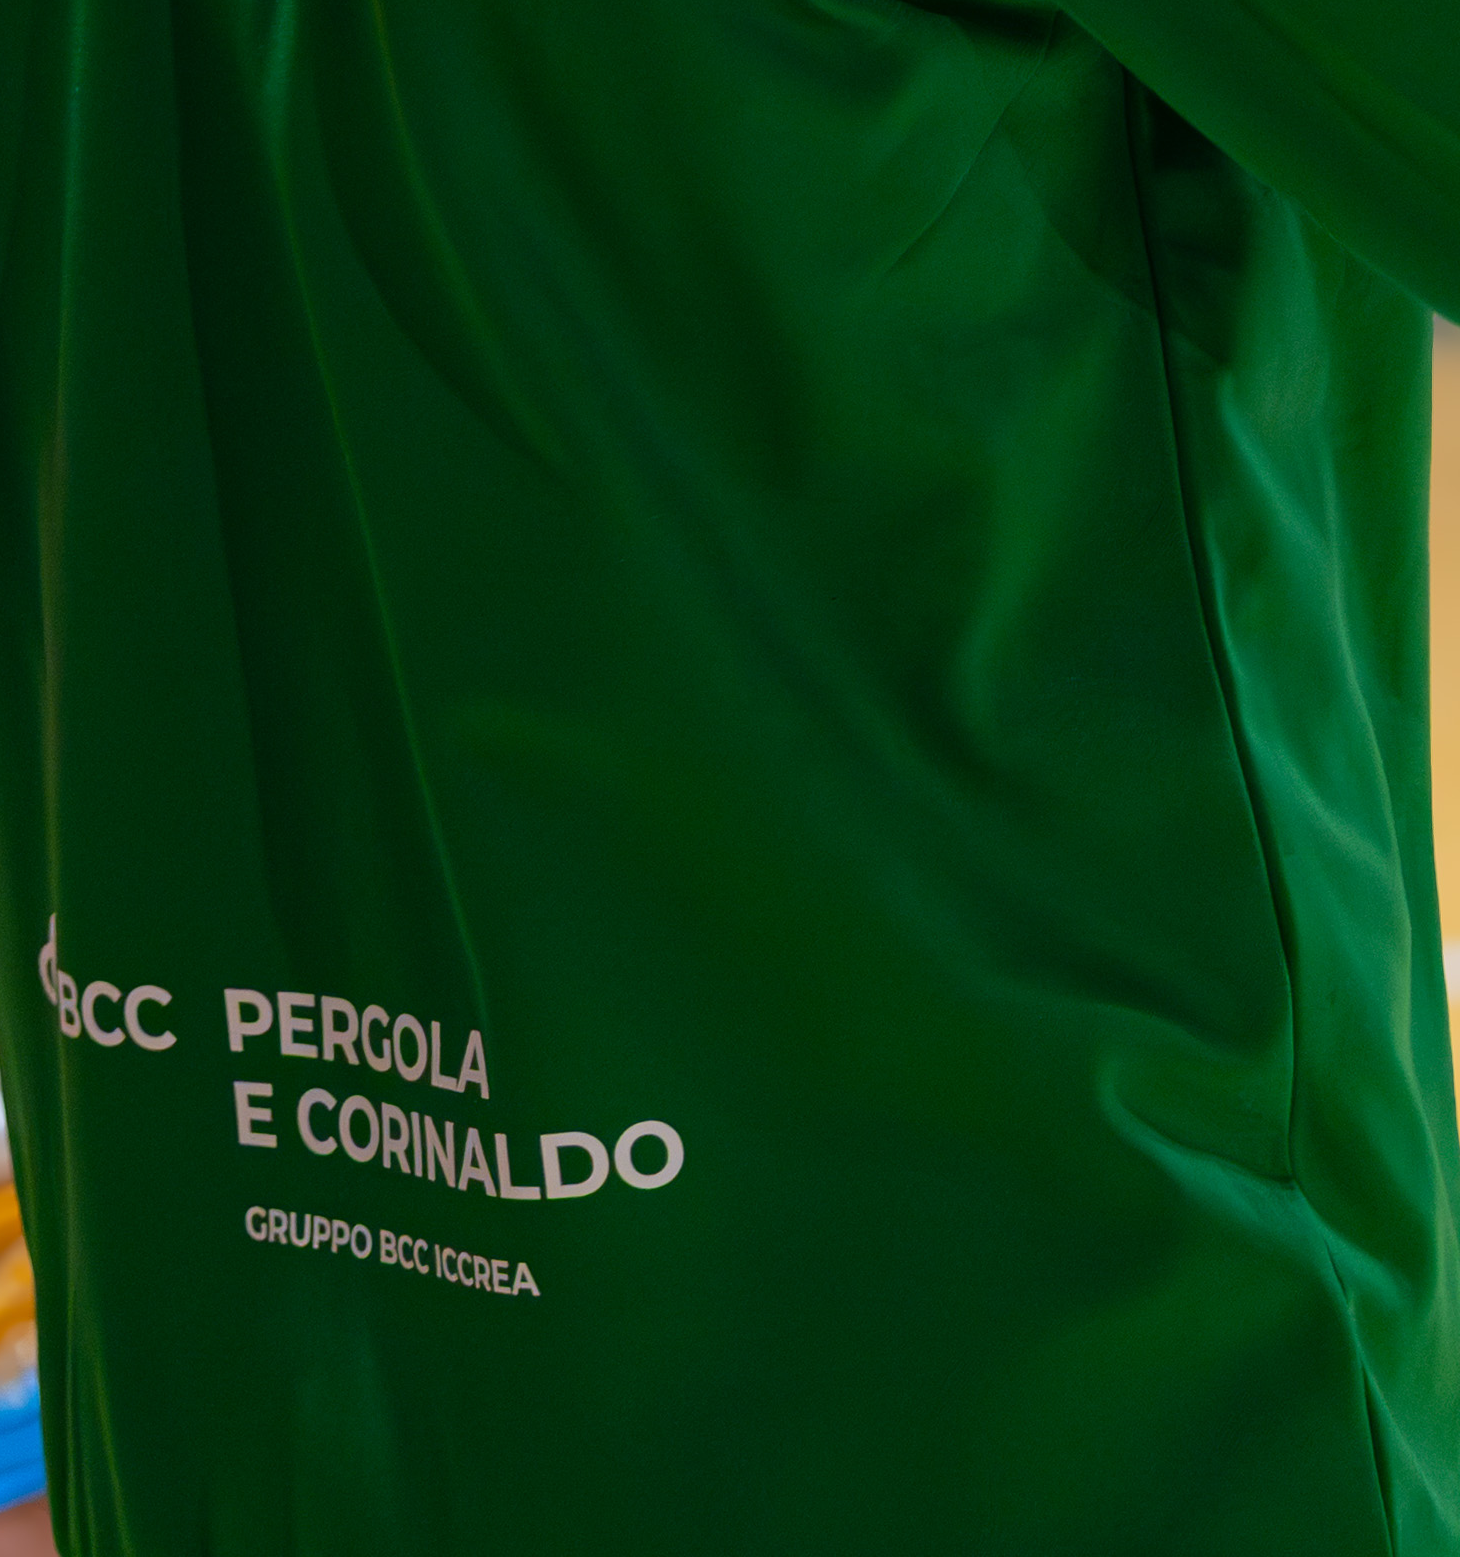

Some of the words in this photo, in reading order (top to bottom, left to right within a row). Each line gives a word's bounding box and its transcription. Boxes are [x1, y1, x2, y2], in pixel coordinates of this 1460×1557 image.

[57, 969, 178, 1051] BCC
[223, 988, 491, 1101] PERGOLA
[233, 1081, 278, 1148] E
[297, 1088, 685, 1200] CORINALDO
[245, 1205, 373, 1260] GRUPPO
[379, 1229, 430, 1274] BCC
[434, 1243, 541, 1297] ICCREA
